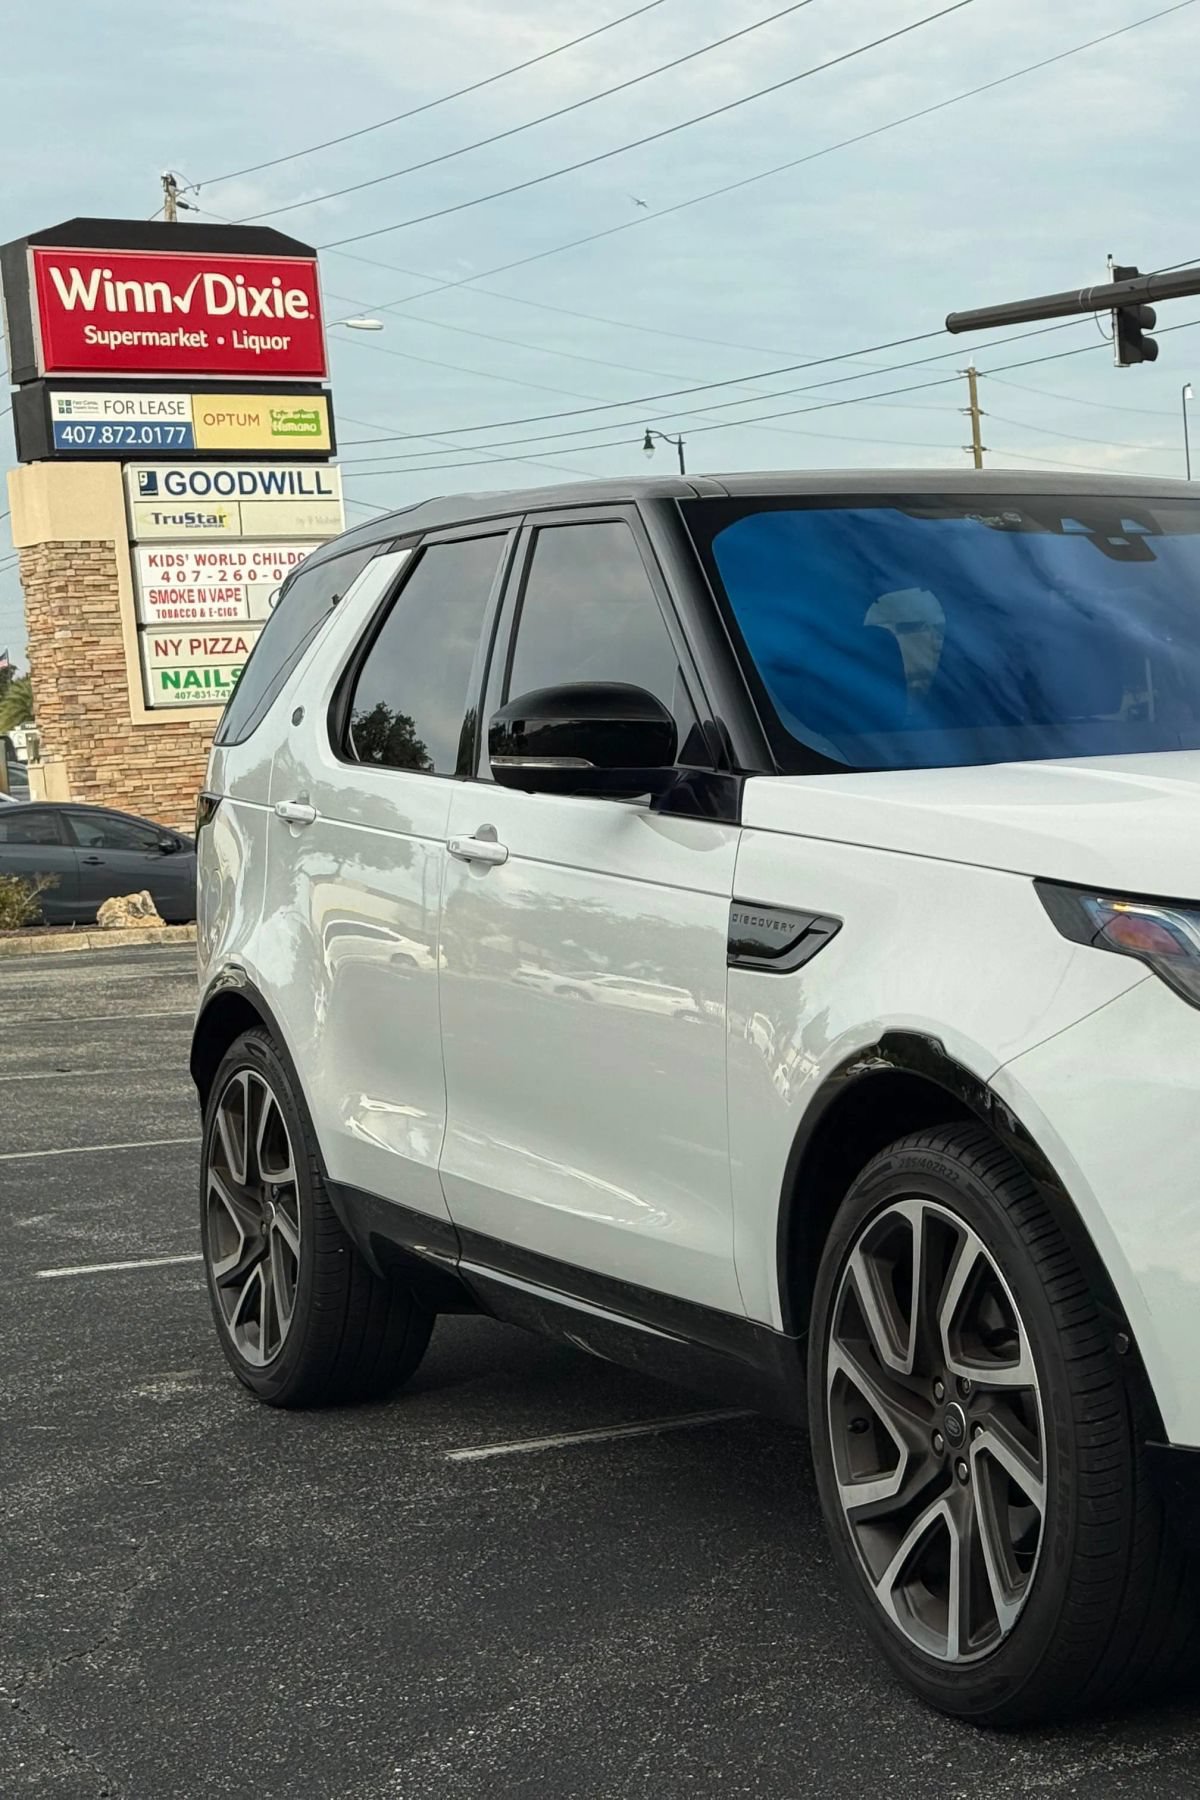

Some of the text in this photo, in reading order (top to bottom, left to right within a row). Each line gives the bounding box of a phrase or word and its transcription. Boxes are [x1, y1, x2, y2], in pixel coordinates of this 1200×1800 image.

[84, 325, 291, 354] Supermarket Liquor
[104, 400, 185, 415] FOR LEASE
[203, 413, 260, 427] OPTUM
[61, 426, 186, 443] 407.872.0177
[164, 470, 332, 496] GOODWILL
[151, 511, 227, 525] TruStar
[148, 554, 189, 567] KIDS'
[194, 553, 247, 566] WORLD
[149, 587, 242, 604] SMOKE N VAPE
[156, 607, 238, 619] TOBACCO & E-CIGS
[154, 637, 249, 656] NY PIZZA
[732, 913, 796, 932] DISCOVERY
